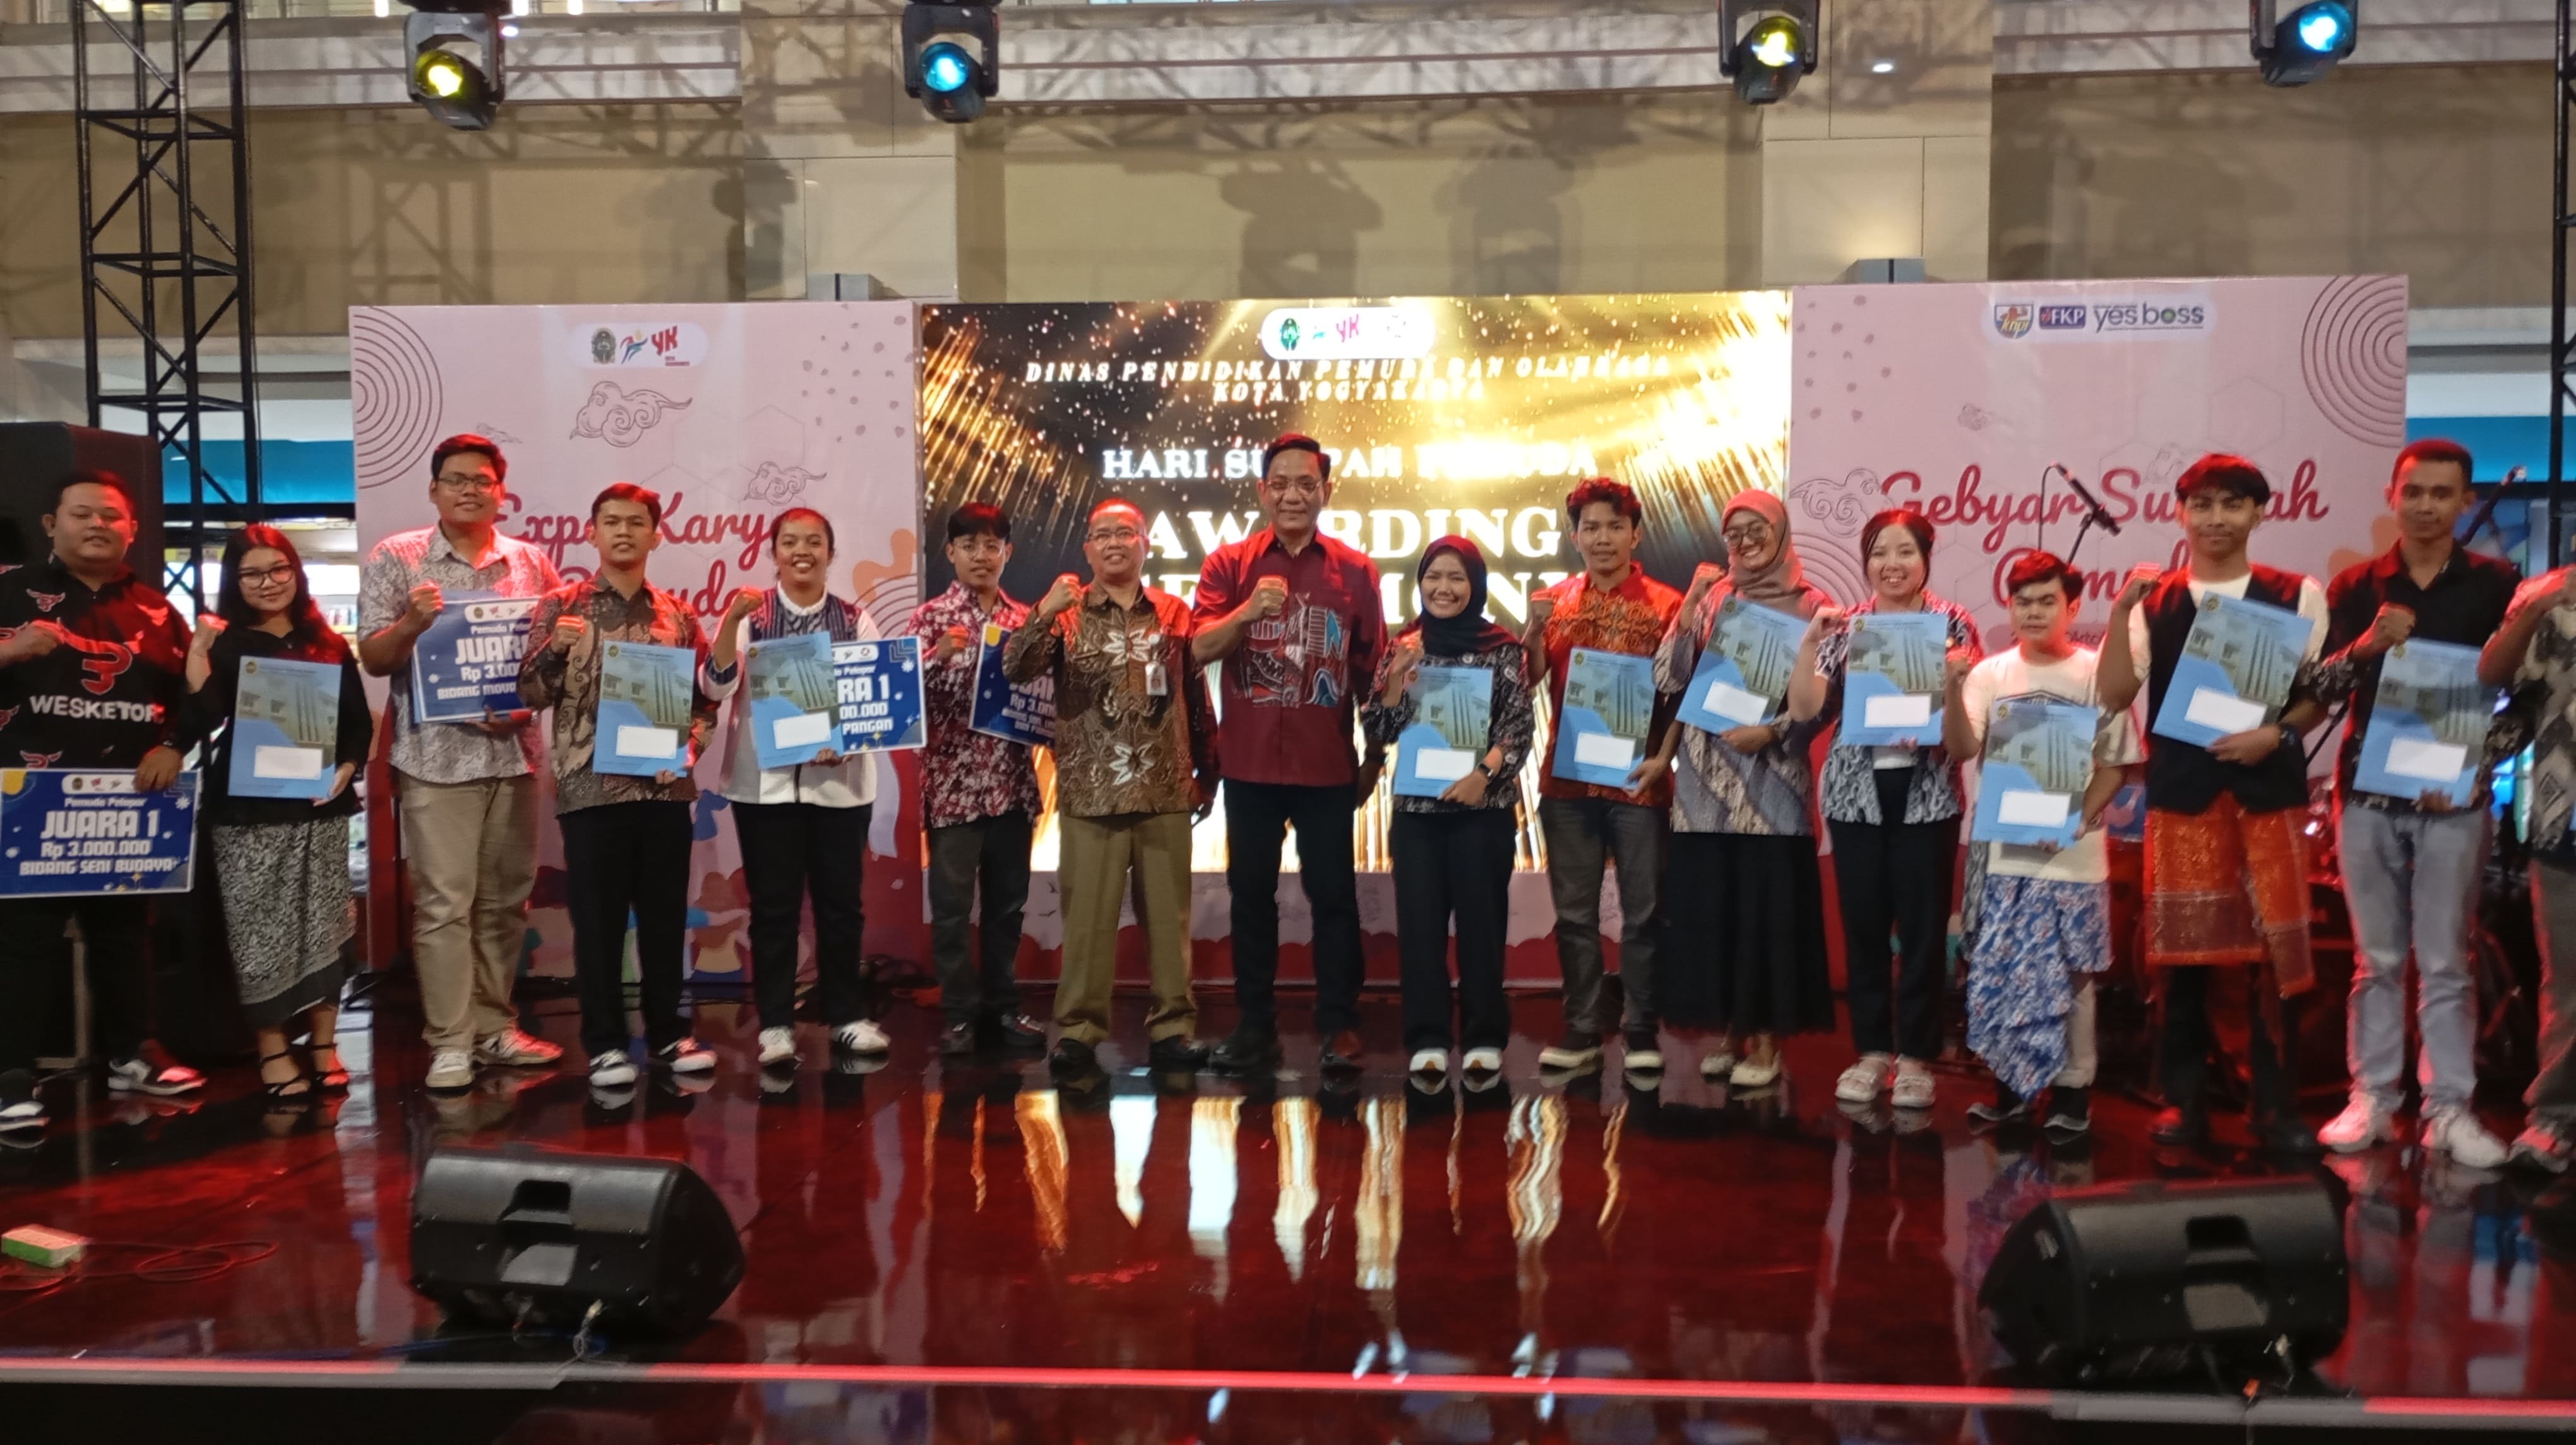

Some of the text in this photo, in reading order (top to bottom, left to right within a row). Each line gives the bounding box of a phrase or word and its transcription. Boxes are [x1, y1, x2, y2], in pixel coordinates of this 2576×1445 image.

[2094, 303, 2204, 333] yes boss
[1026, 362, 1109, 382] DINAS
[1123, 361, 1303, 381] PENDIDIKAN
[1213, 382, 1285, 403] KOTA
[1102, 449, 1208, 479] HARI
[2100, 460, 2329, 525] Suah
[655, 492, 773, 570] Kary
[1147, 509, 1561, 559] AWRDING
[461, 666, 482, 683] Rp
[878, 673, 890, 700] 1
[843, 717, 893, 735] PANGAN
[64, 797, 148, 808] Pemuda Pelopor
[40, 809, 160, 839] JUARA 1
[40, 839, 153, 860] Rp 3.000.000
[20, 858, 174, 876] BIDANG SENI BUDAYA
